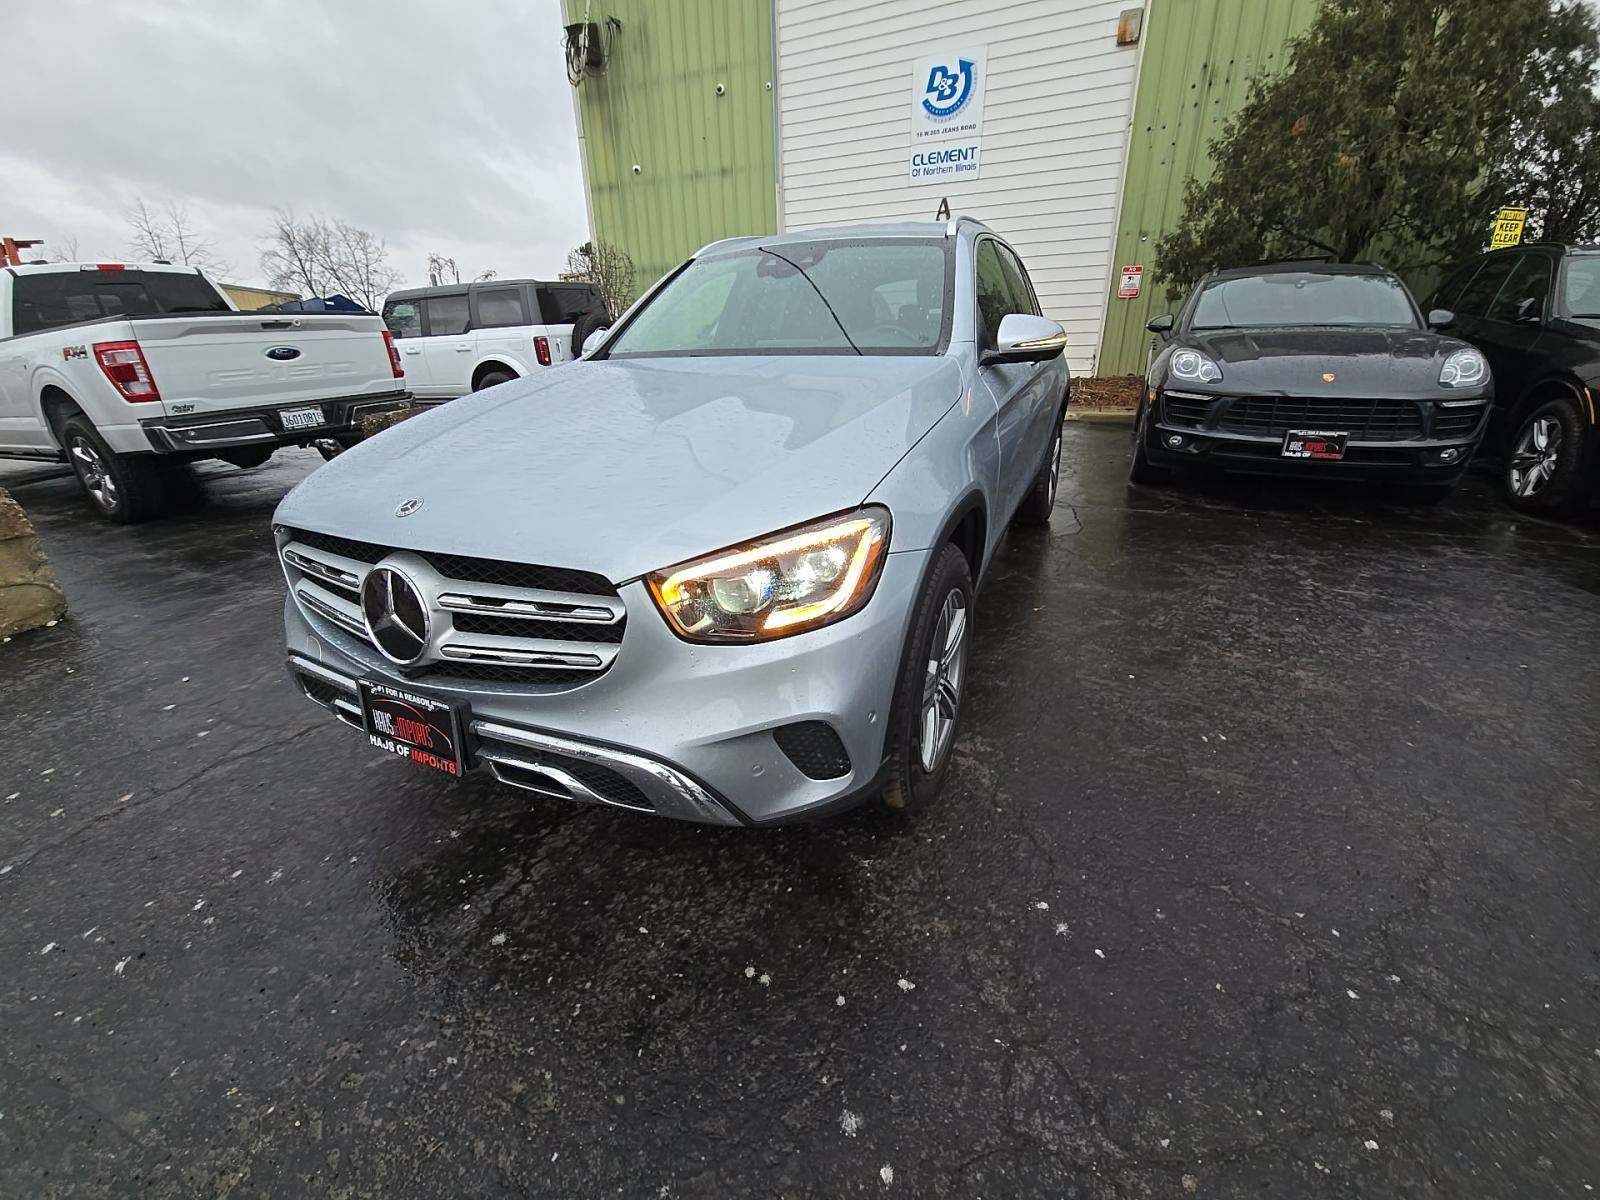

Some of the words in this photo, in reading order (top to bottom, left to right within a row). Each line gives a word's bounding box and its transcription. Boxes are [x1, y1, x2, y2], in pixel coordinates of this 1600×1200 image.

[926, 66, 959, 101] D&B
[941, 126, 960, 134] JEANS
[912, 146, 978, 167] CLEMENT
[911, 168, 921, 177] Of
[923, 165, 953, 176] Northern
[955, 162, 977, 172] Illinois
[935, 197, 951, 221] A
[1499, 222, 1519, 231] KEEP
[1494, 233, 1519, 243] CLEAR
[385, 687, 398, 697] FOR
[399, 690, 405, 699] A
[404, 693, 432, 707] REASON
[396, 744, 410, 757] OF
